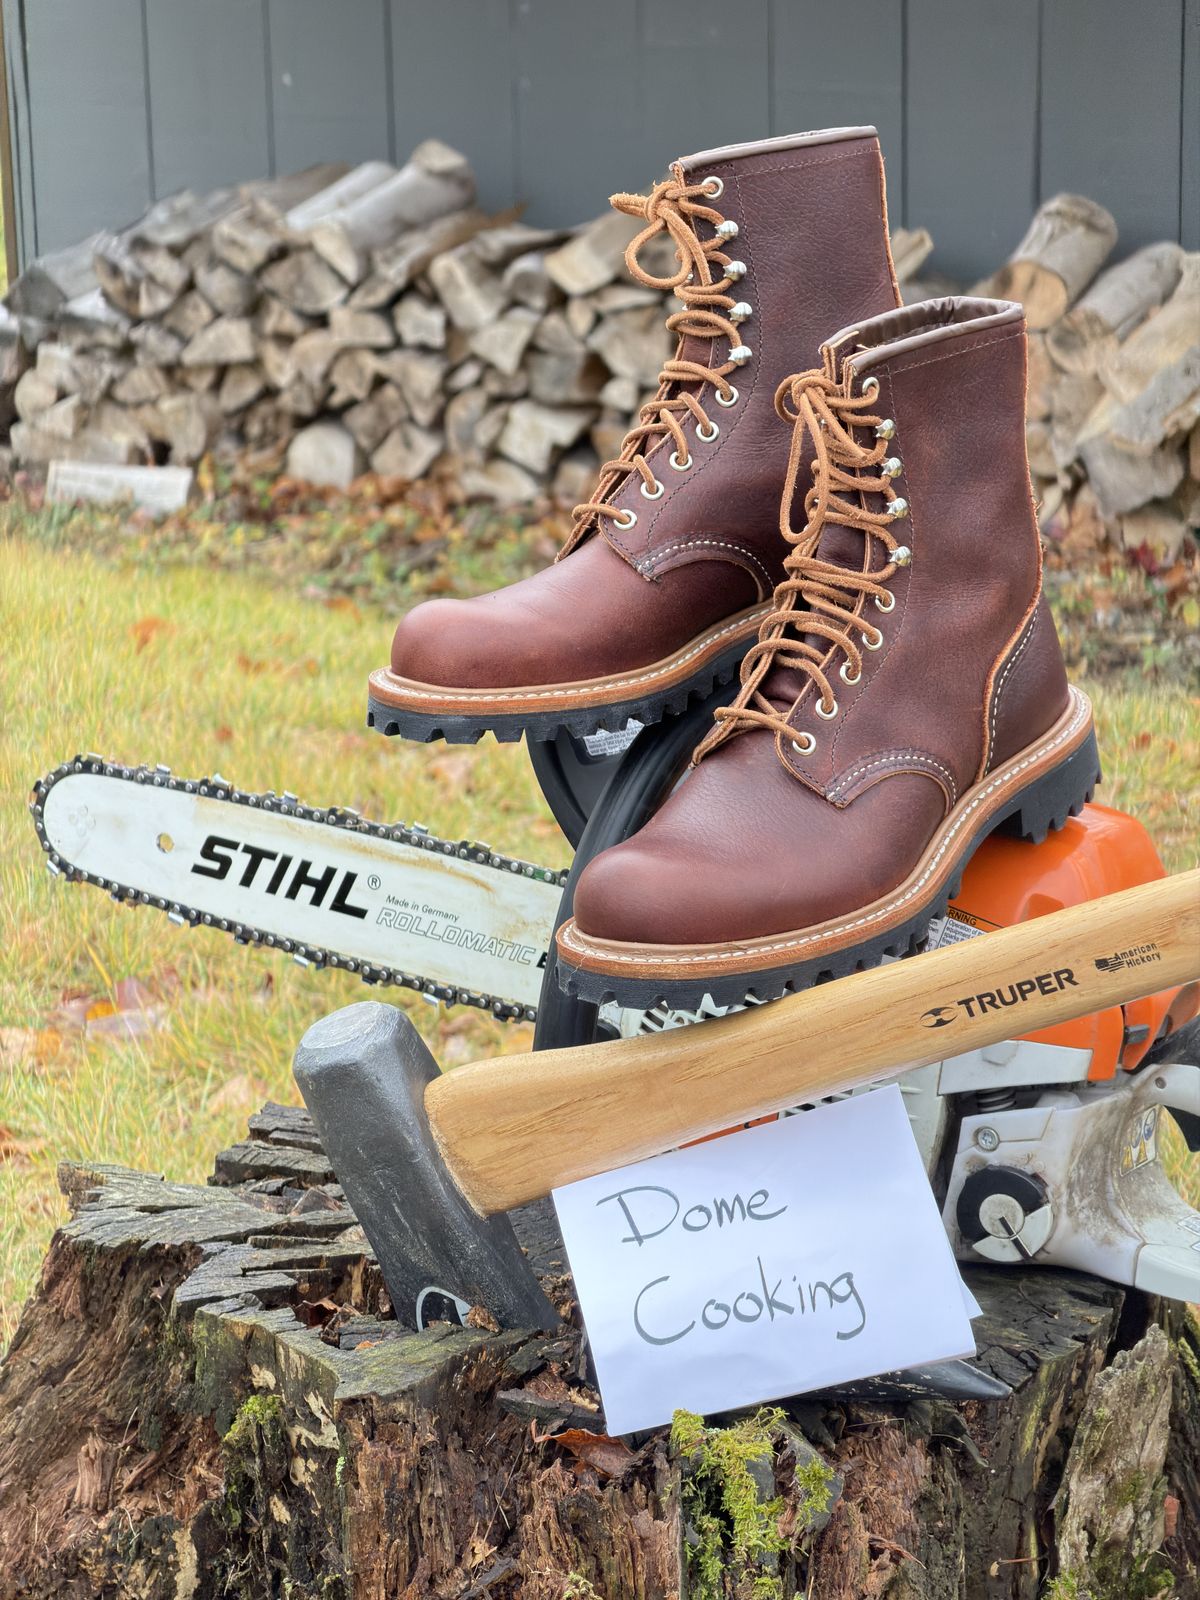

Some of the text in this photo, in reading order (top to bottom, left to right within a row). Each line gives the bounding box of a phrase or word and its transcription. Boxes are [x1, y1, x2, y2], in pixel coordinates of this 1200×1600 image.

[386, 894, 460, 923] Made in Germany
[946, 908, 977, 926] RNING
[376, 907, 537, 966] ROLLOMATIC
[1114, 943, 1157, 961] American
[1125, 952, 1161, 968] Hickory
[957, 968, 1079, 1018] TRUPER
[596, 1185, 788, 1247] Dome
[634, 1256, 866, 1345] Cooking
